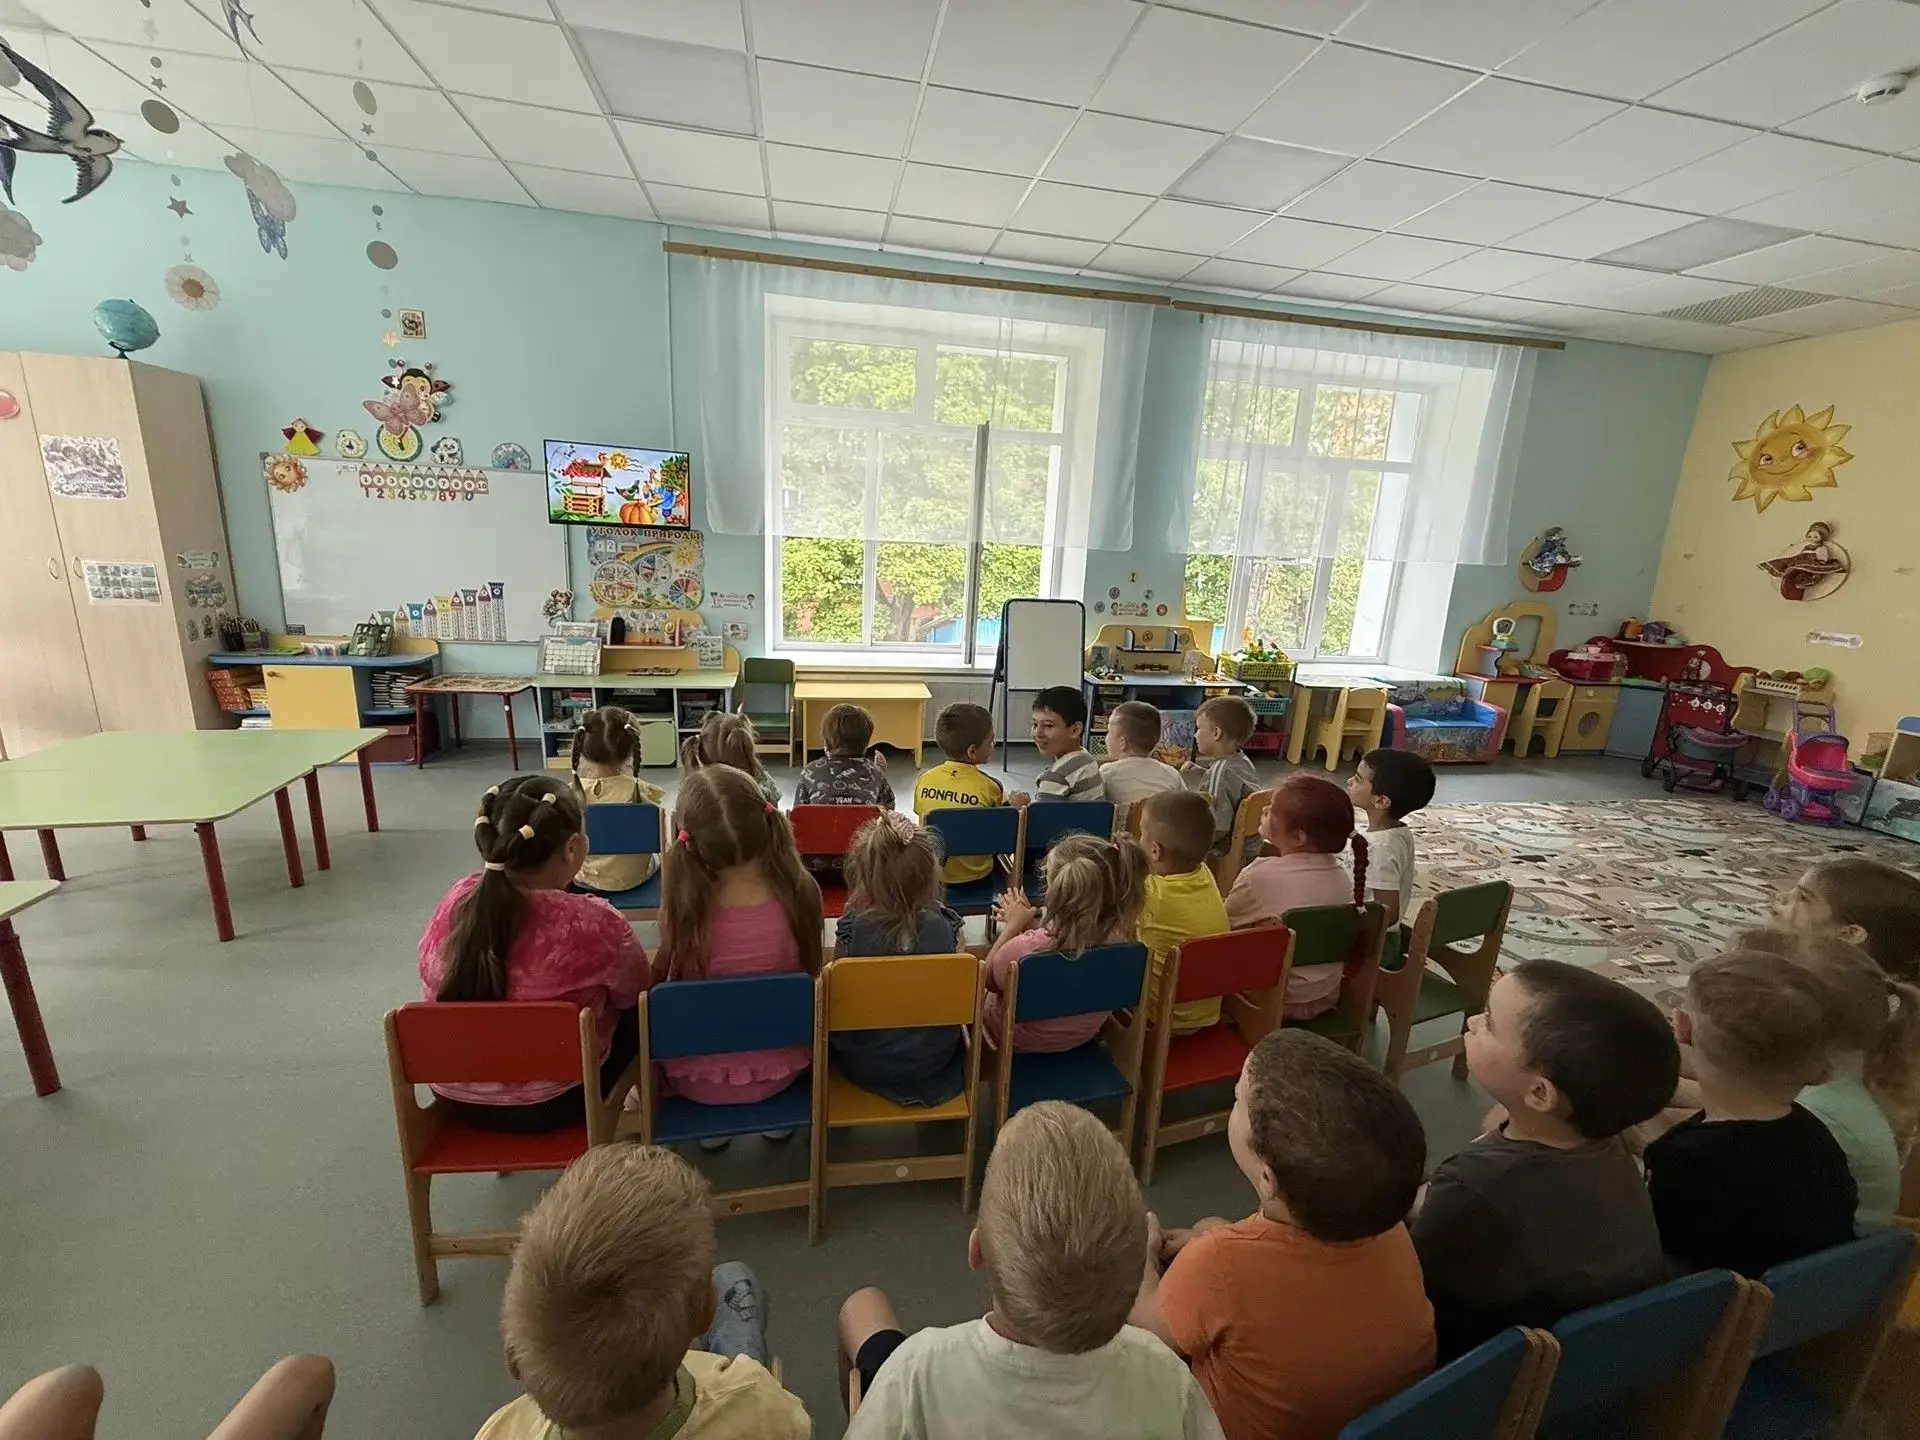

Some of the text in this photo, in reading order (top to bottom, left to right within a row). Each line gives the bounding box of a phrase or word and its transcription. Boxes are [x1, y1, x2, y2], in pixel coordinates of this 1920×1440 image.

[364, 488, 369, 498] 1
[376, 489, 384, 499] 2
[398, 490, 405, 500] 4
[409, 490, 416, 500] 5
[420, 491, 427, 500] 6
[439, 491, 446, 501] 8
[449, 491, 455, 500] 9
[591, 527, 701, 540] УГОЛОК ПРИРОДЫ
[921, 787, 979, 806] RONALDO
